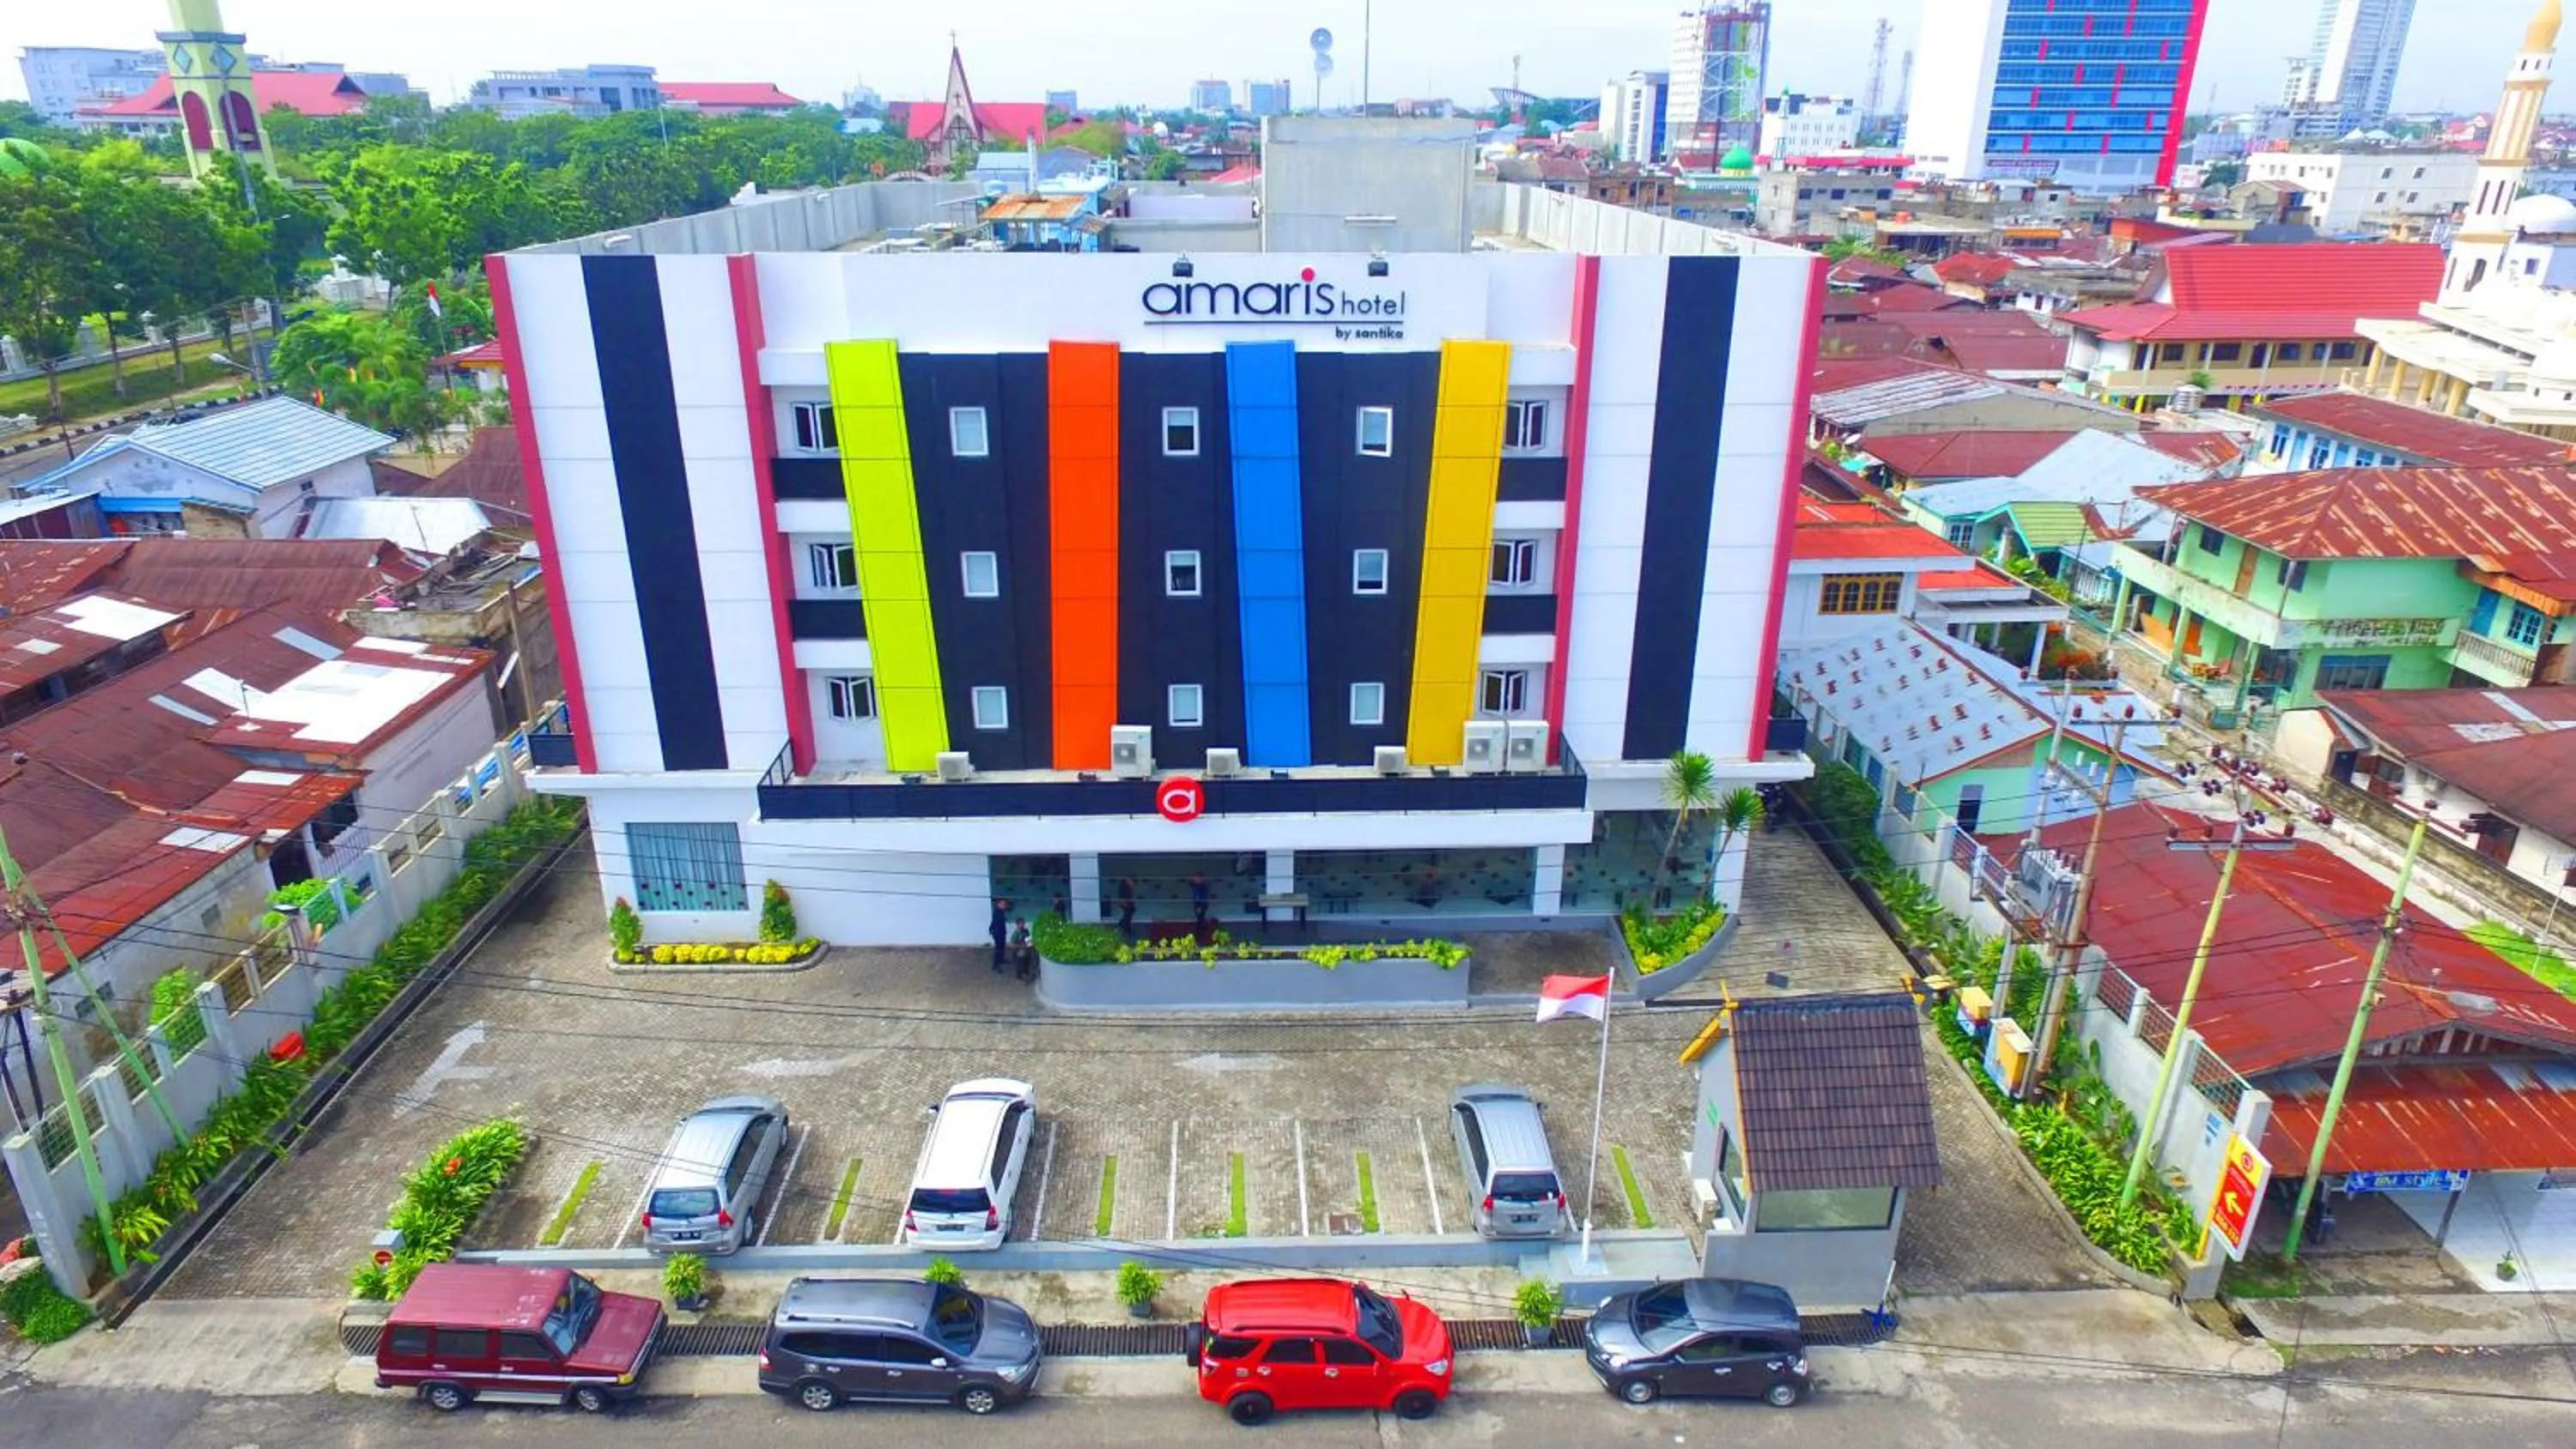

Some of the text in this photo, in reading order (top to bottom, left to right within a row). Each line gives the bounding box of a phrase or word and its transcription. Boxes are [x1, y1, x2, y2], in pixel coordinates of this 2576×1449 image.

[1142, 267, 1406, 315] amaris hotel
[1335, 325, 1404, 341] by santika
